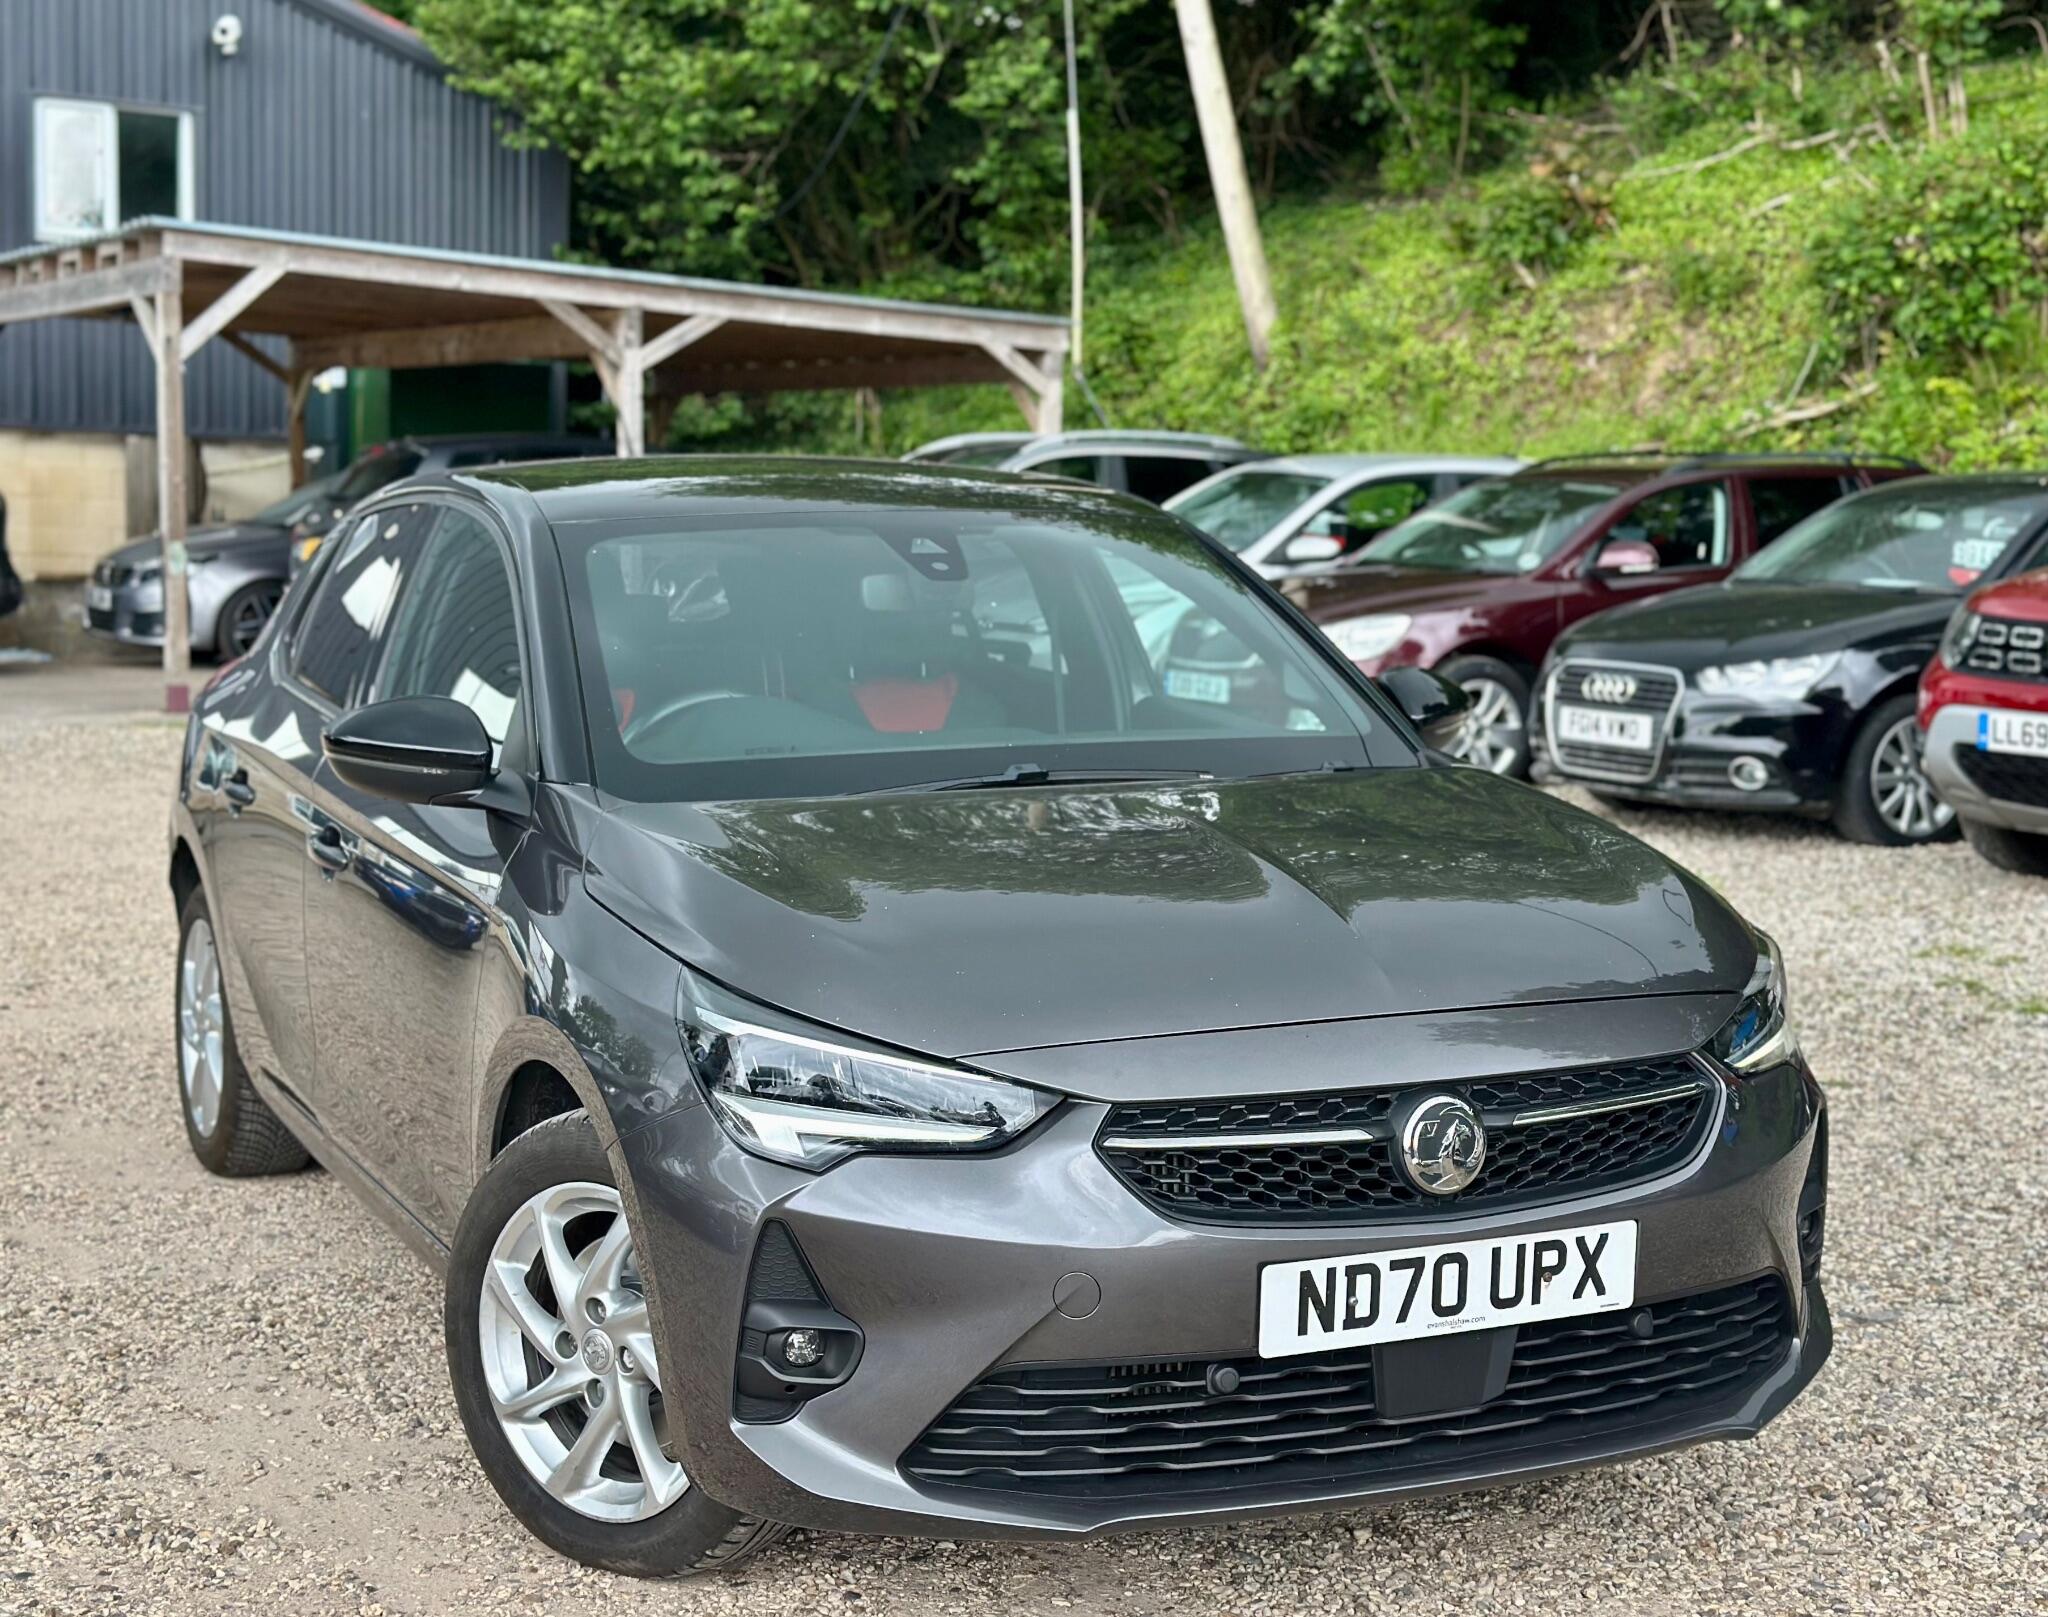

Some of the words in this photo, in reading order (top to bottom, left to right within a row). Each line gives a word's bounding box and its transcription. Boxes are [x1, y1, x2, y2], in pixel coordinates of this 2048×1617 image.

[1992, 717, 2048, 749] LL69
[1297, 1251, 1469, 1337] ND70
[1489, 1232, 1609, 1310] UPX
[1427, 1316, 1486, 1329] evanshalshaw.com
